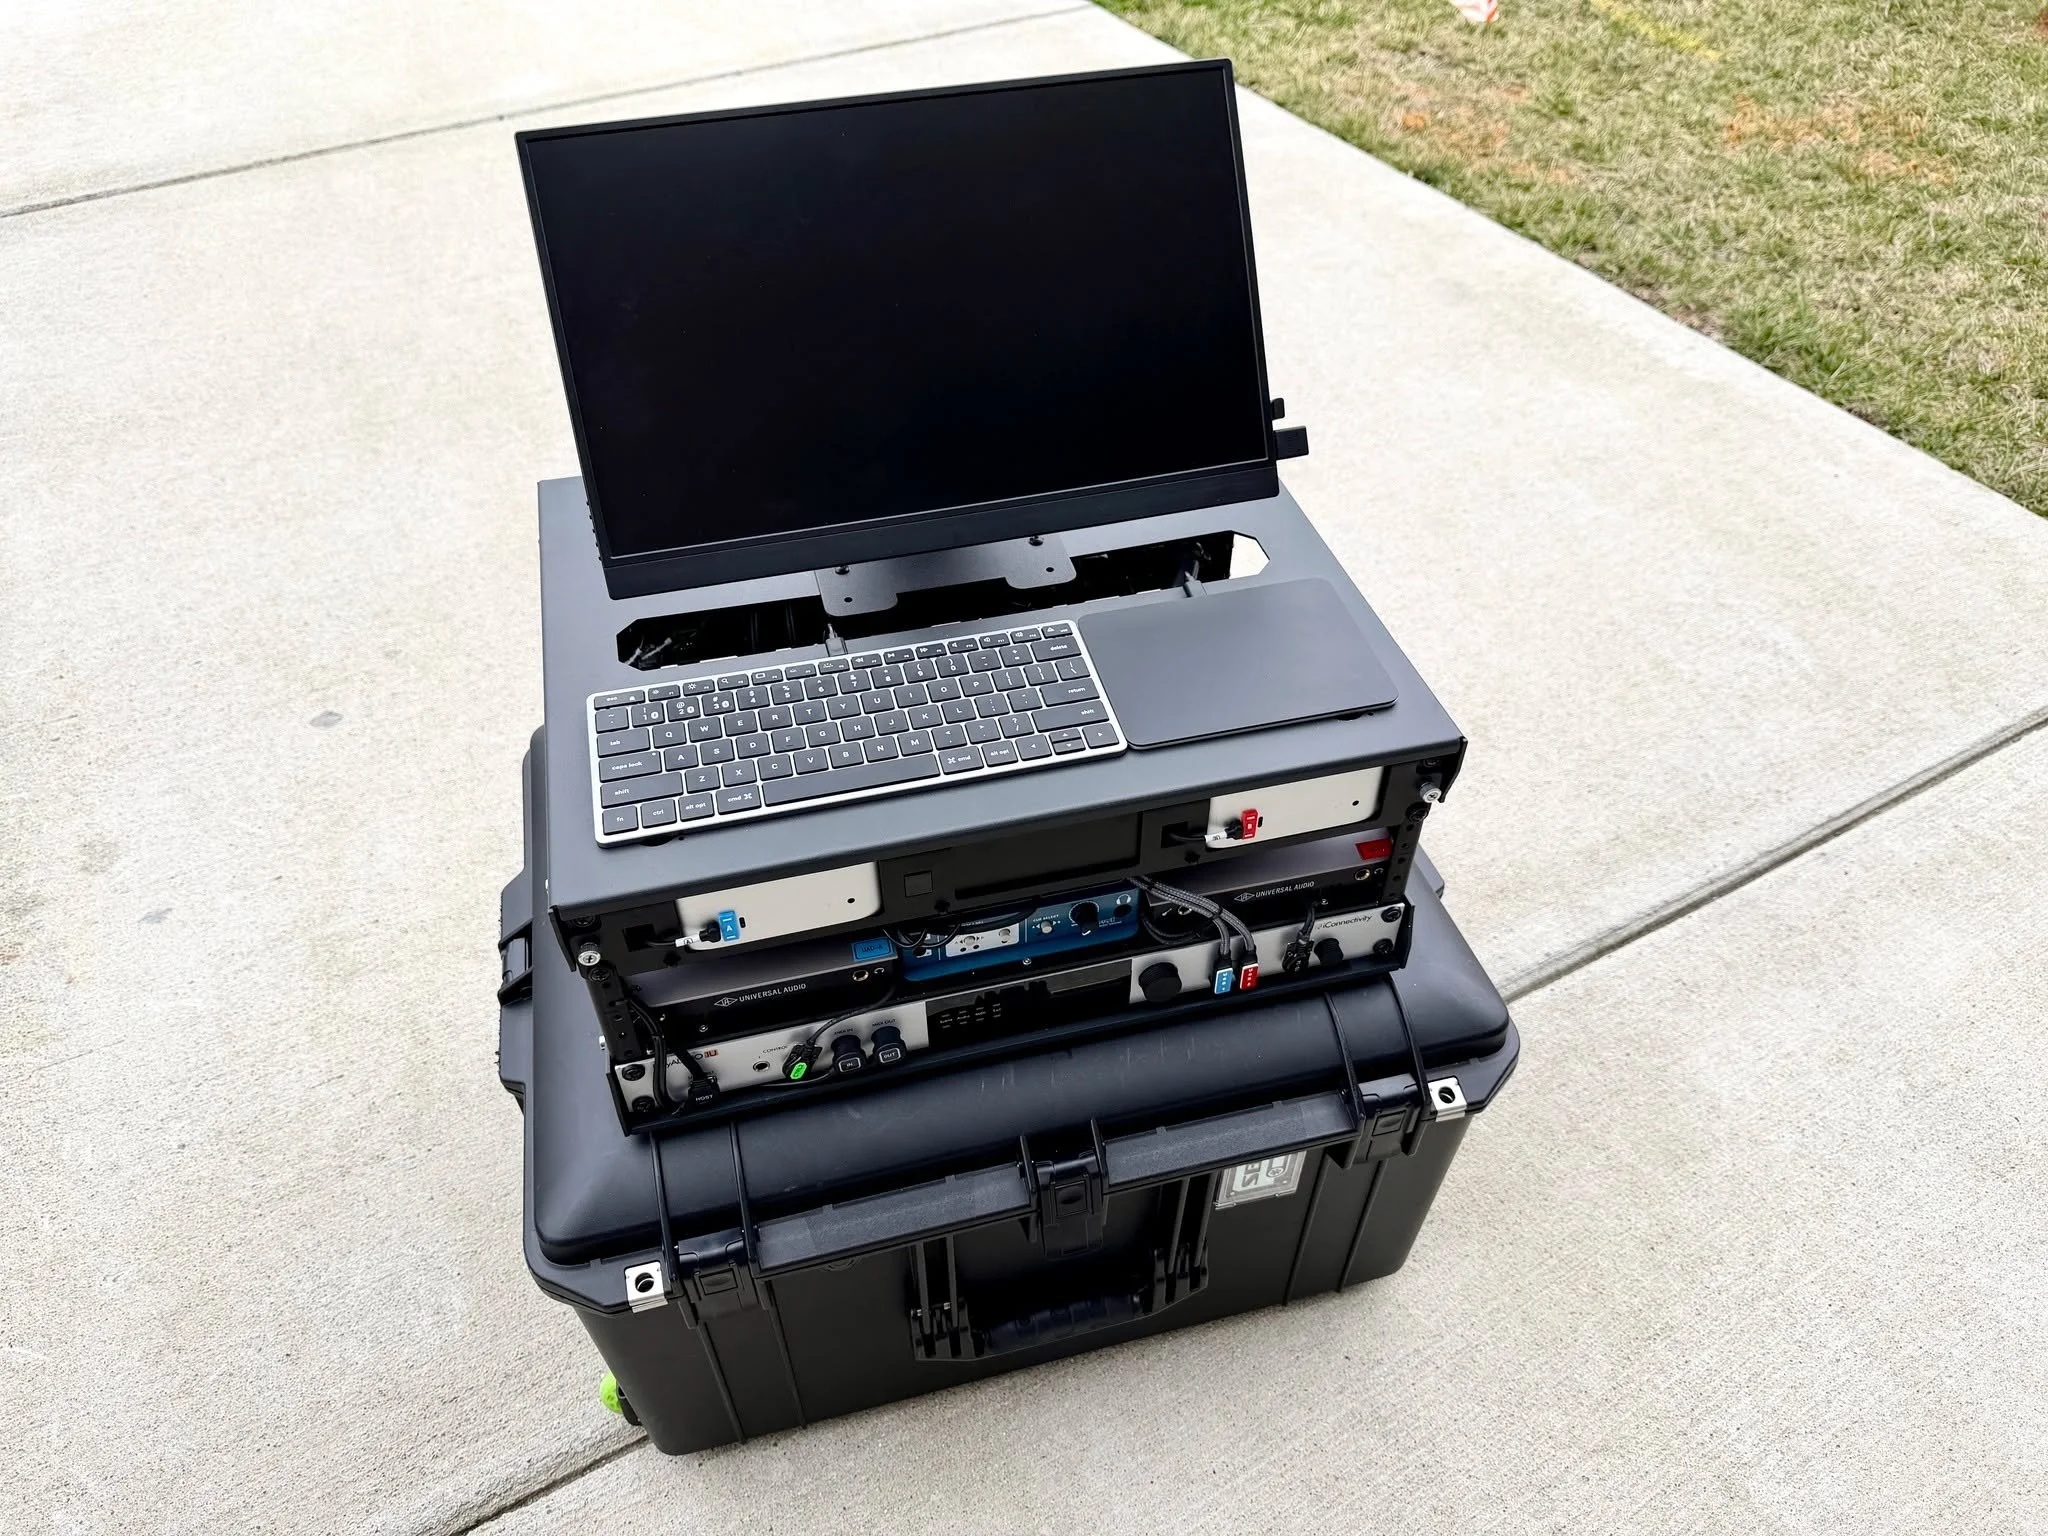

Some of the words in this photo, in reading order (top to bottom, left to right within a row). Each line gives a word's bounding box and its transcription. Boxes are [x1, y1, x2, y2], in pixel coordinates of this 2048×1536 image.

[676, 701, 685, 709] @
[737, 719, 744, 727] E
[853, 724, 862, 732] H
[785, 735, 791, 743] F
[807, 756, 814, 764] V
[614, 788, 630, 796] shift
[727, 795, 742, 803] cmd
[1255, 885, 1293, 898] UNIVERSAL
[1293, 880, 1315, 890] AUDIO
[1322, 915, 1373, 928] iConnectivity
[739, 988, 782, 1002] UNIVERSAL
[783, 983, 807, 993] AUDIO
[695, 1094, 713, 1102] HOST
